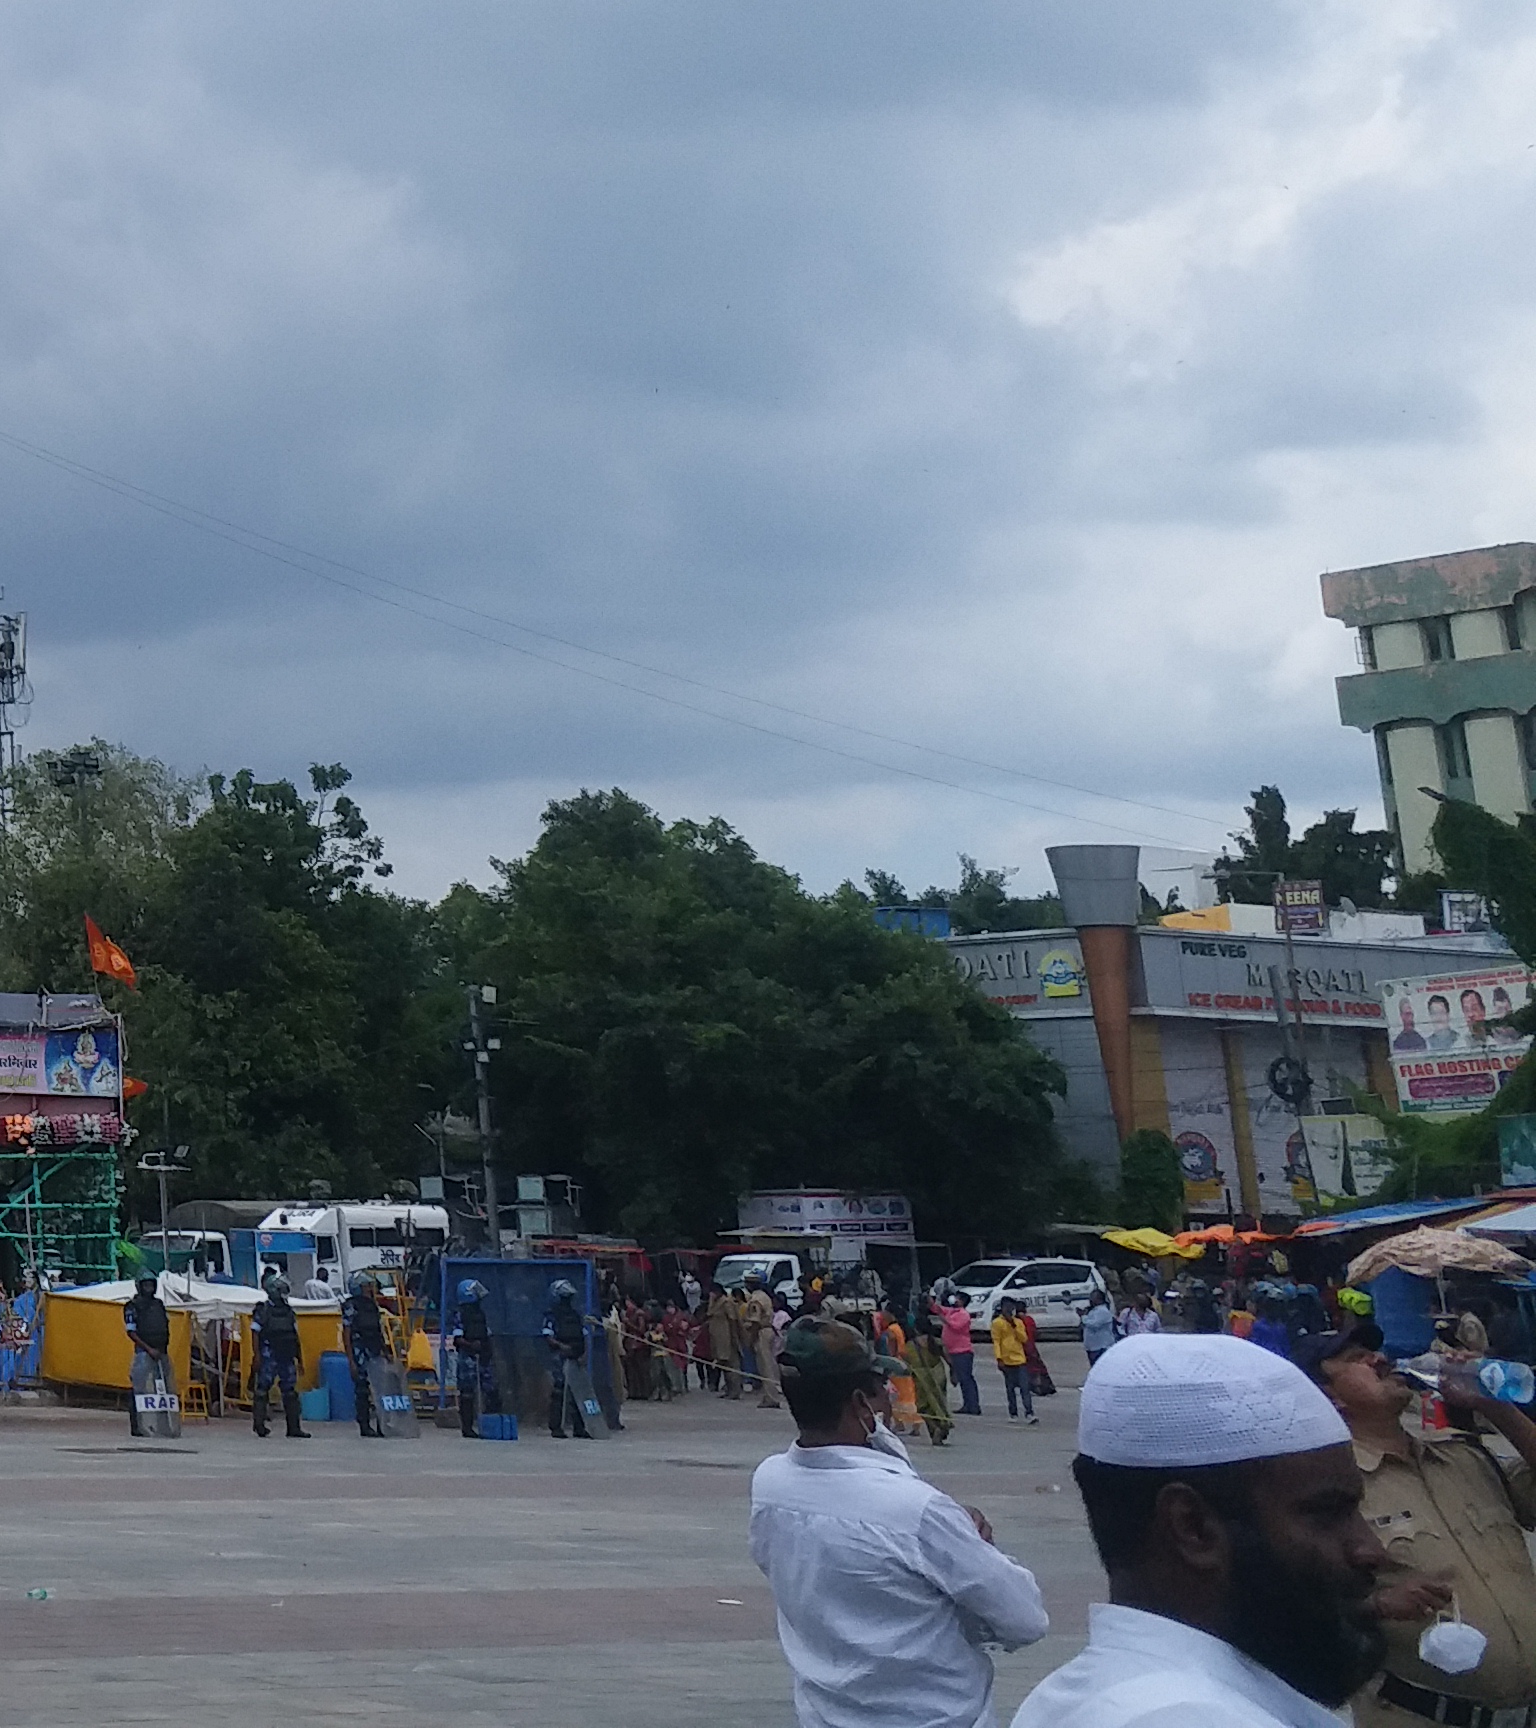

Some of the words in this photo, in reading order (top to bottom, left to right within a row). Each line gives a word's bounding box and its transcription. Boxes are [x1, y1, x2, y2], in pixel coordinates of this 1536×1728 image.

[1181, 941, 1217, 957] PURE
[1219, 945, 1247, 959] VEG
[1246, 962, 1368, 997] MSQATI
[1188, 992, 1212, 1008] ICE
[1399, 1063, 1434, 1078] FLAG
[1436, 1057, 1502, 1075] HOSTING
[143, 1396, 176, 1409] RAF
[382, 1395, 412, 1411] RAF
